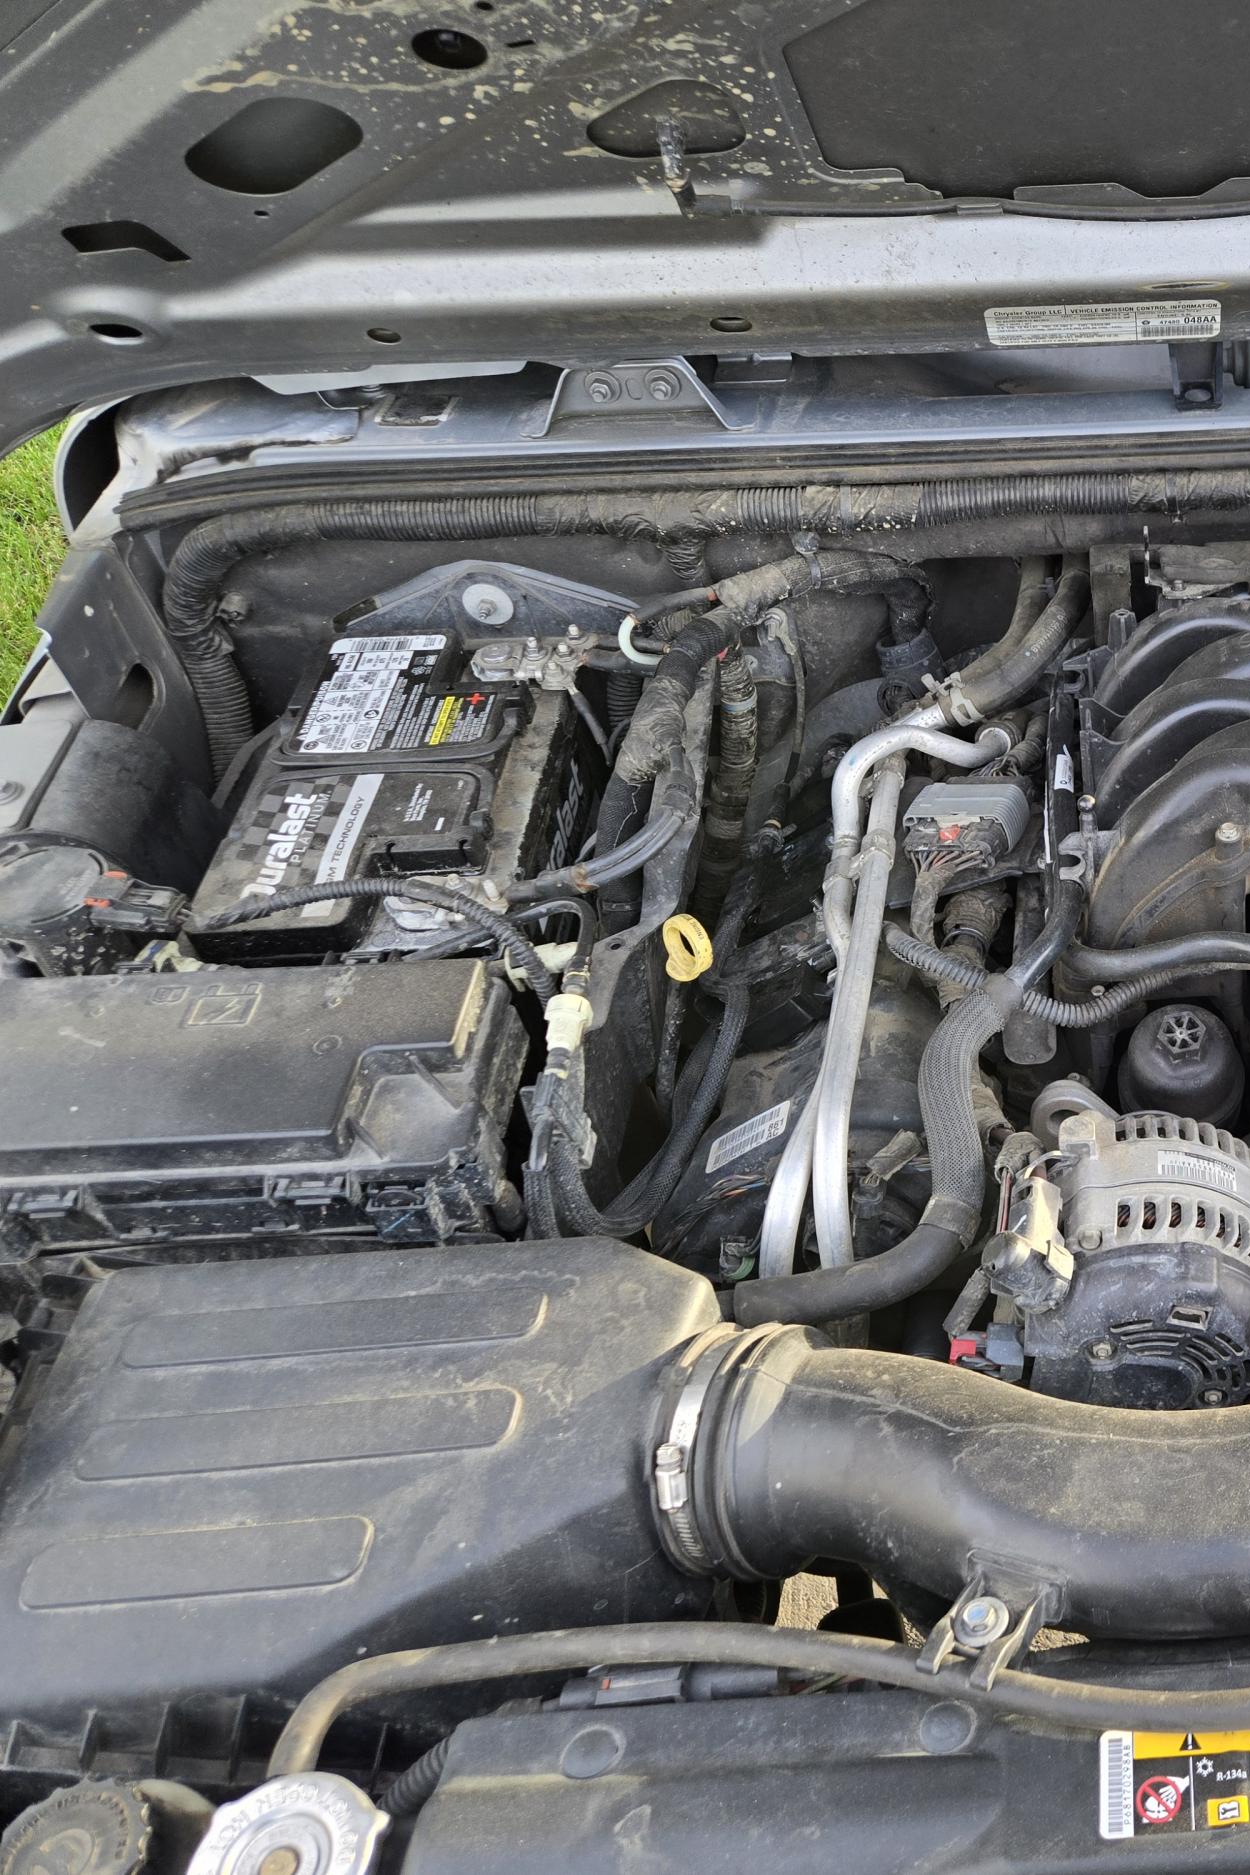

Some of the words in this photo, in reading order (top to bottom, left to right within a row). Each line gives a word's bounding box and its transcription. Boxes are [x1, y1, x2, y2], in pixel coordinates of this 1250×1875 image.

[1183, 316, 1217, 324] 048AA
[240, 792, 318, 899] Duralast
[331, 796, 365, 863] TECHNOLOGY
[1216, 1768, 1248, 1782] R-134a
